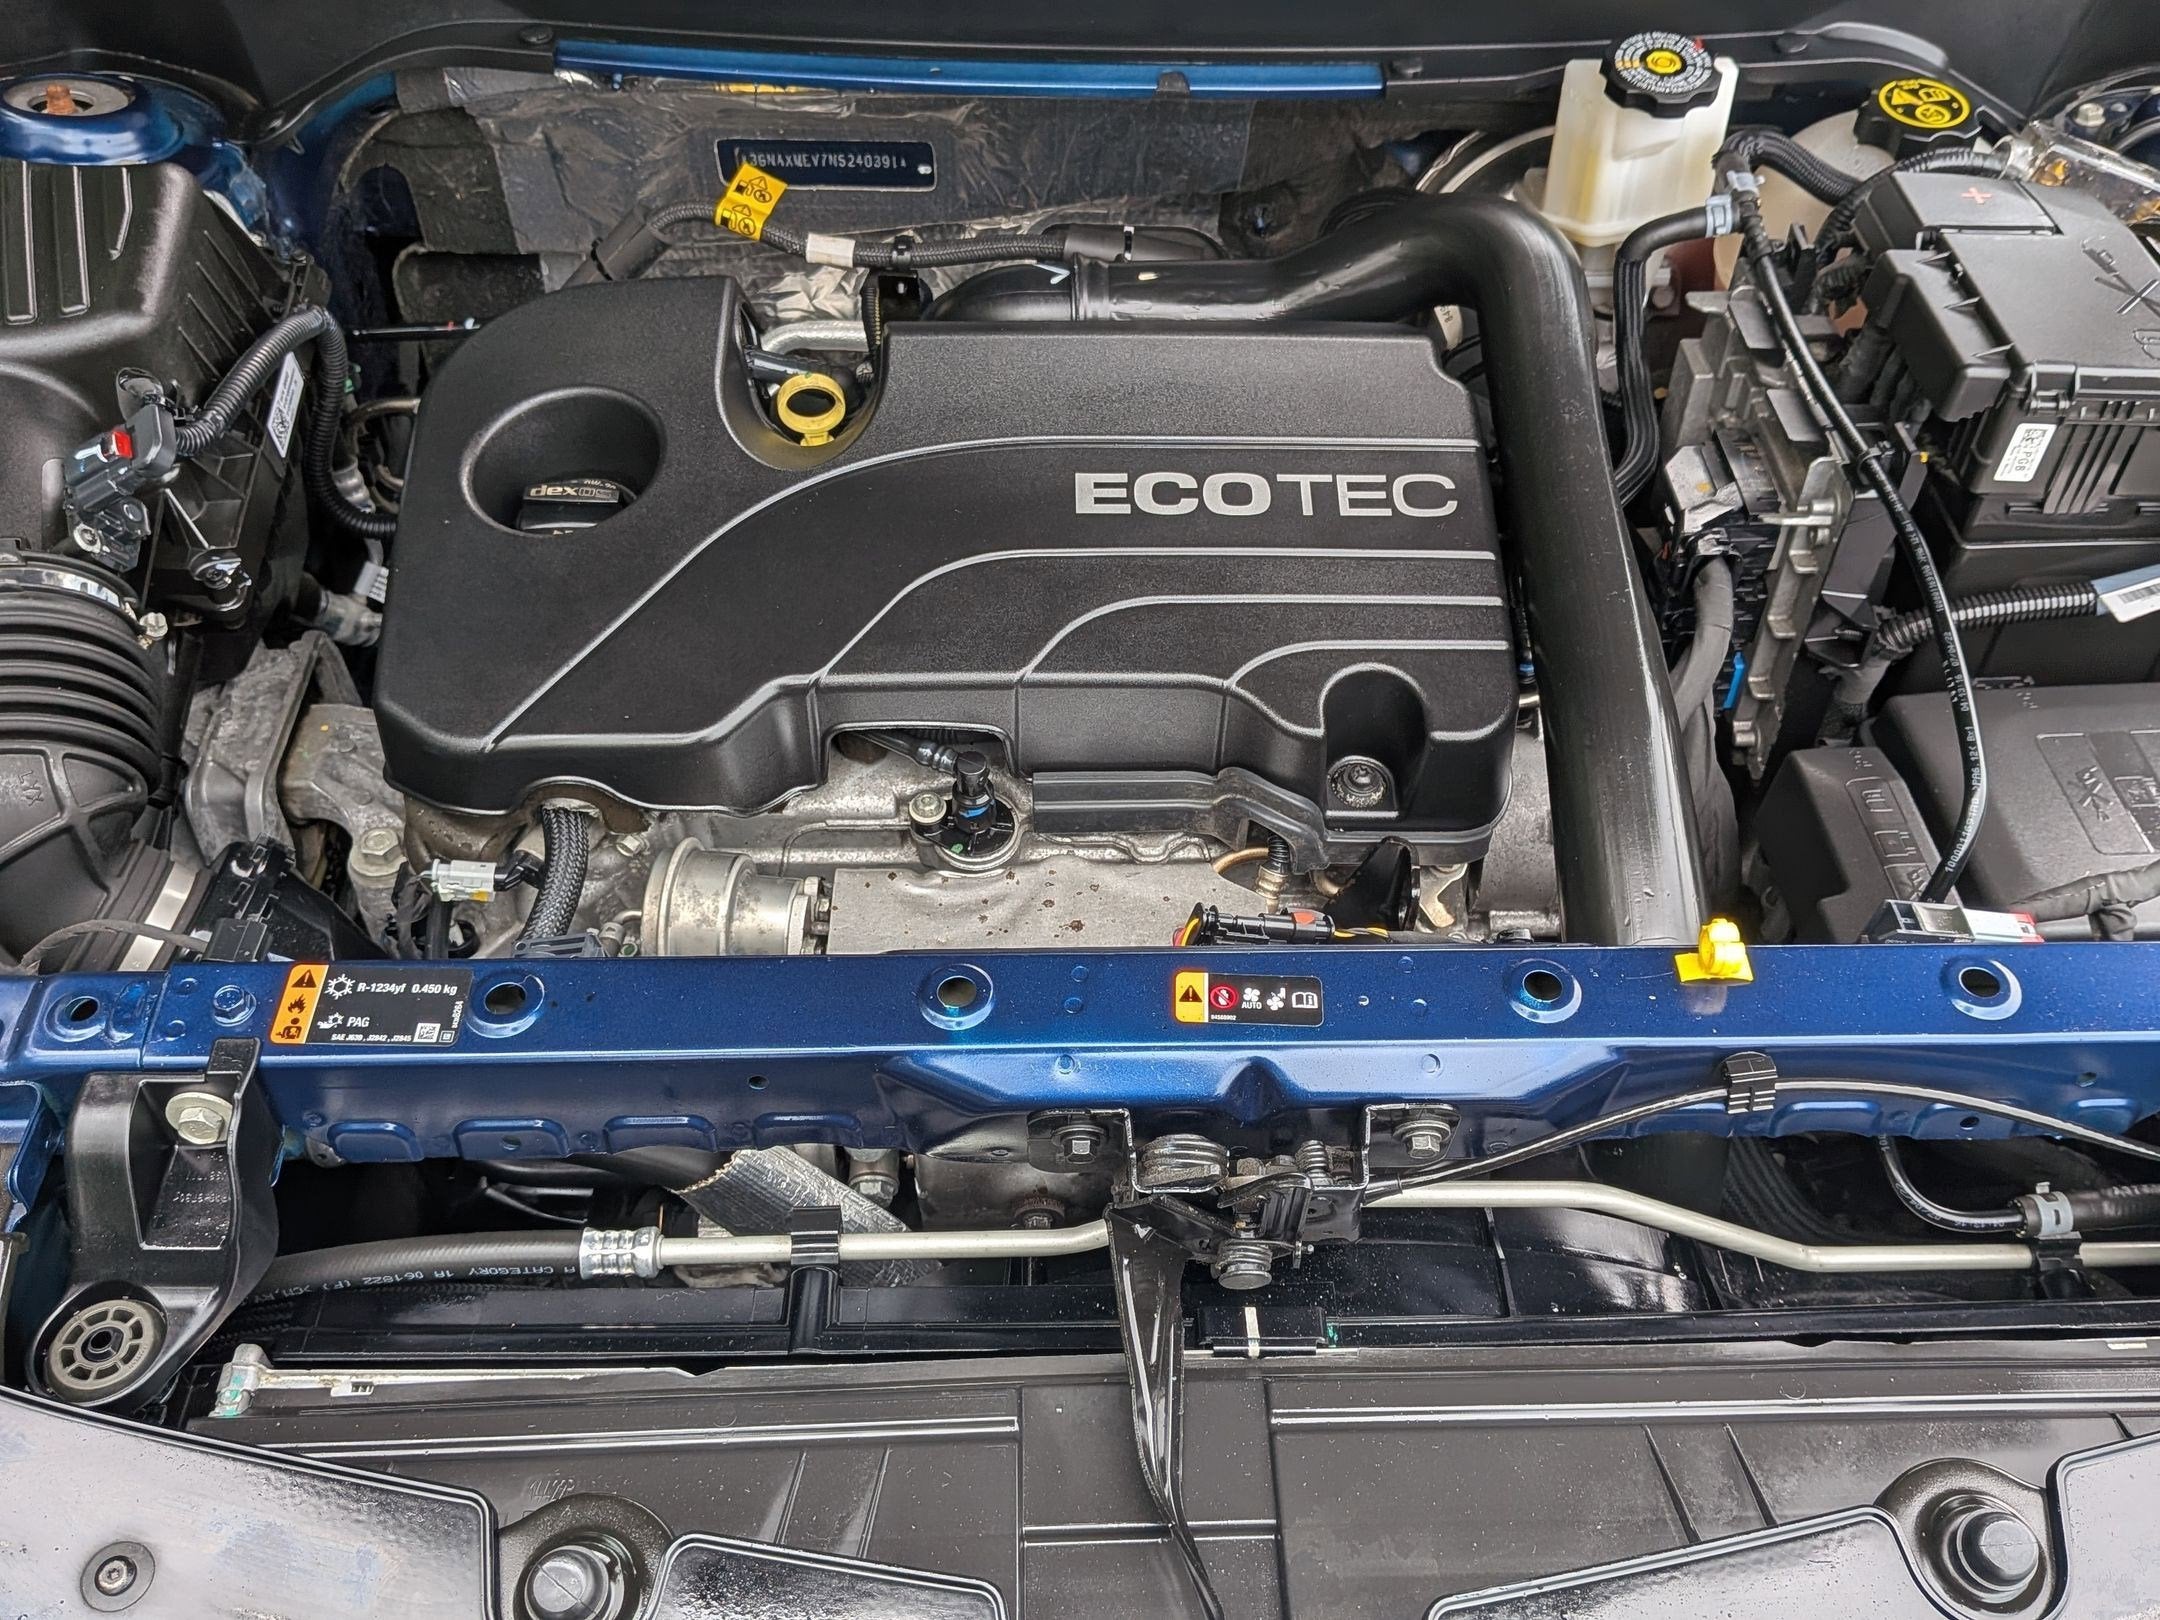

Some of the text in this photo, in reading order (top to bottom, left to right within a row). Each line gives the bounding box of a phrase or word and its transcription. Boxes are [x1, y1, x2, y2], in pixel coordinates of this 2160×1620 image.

[530, 484, 613, 499] dexos
[1075, 472, 1458, 517] ECOTEC
[357, 983, 458, 995] R-1234yf 0.450 kg
[1241, 1001, 1262, 1009] AUTO
[346, 1016, 370, 1028] PAG
[331, 1033, 346, 1041] SAE
[362, 1270, 425, 1286] 061822
[468, 1267, 554, 1277] CATEGORY
